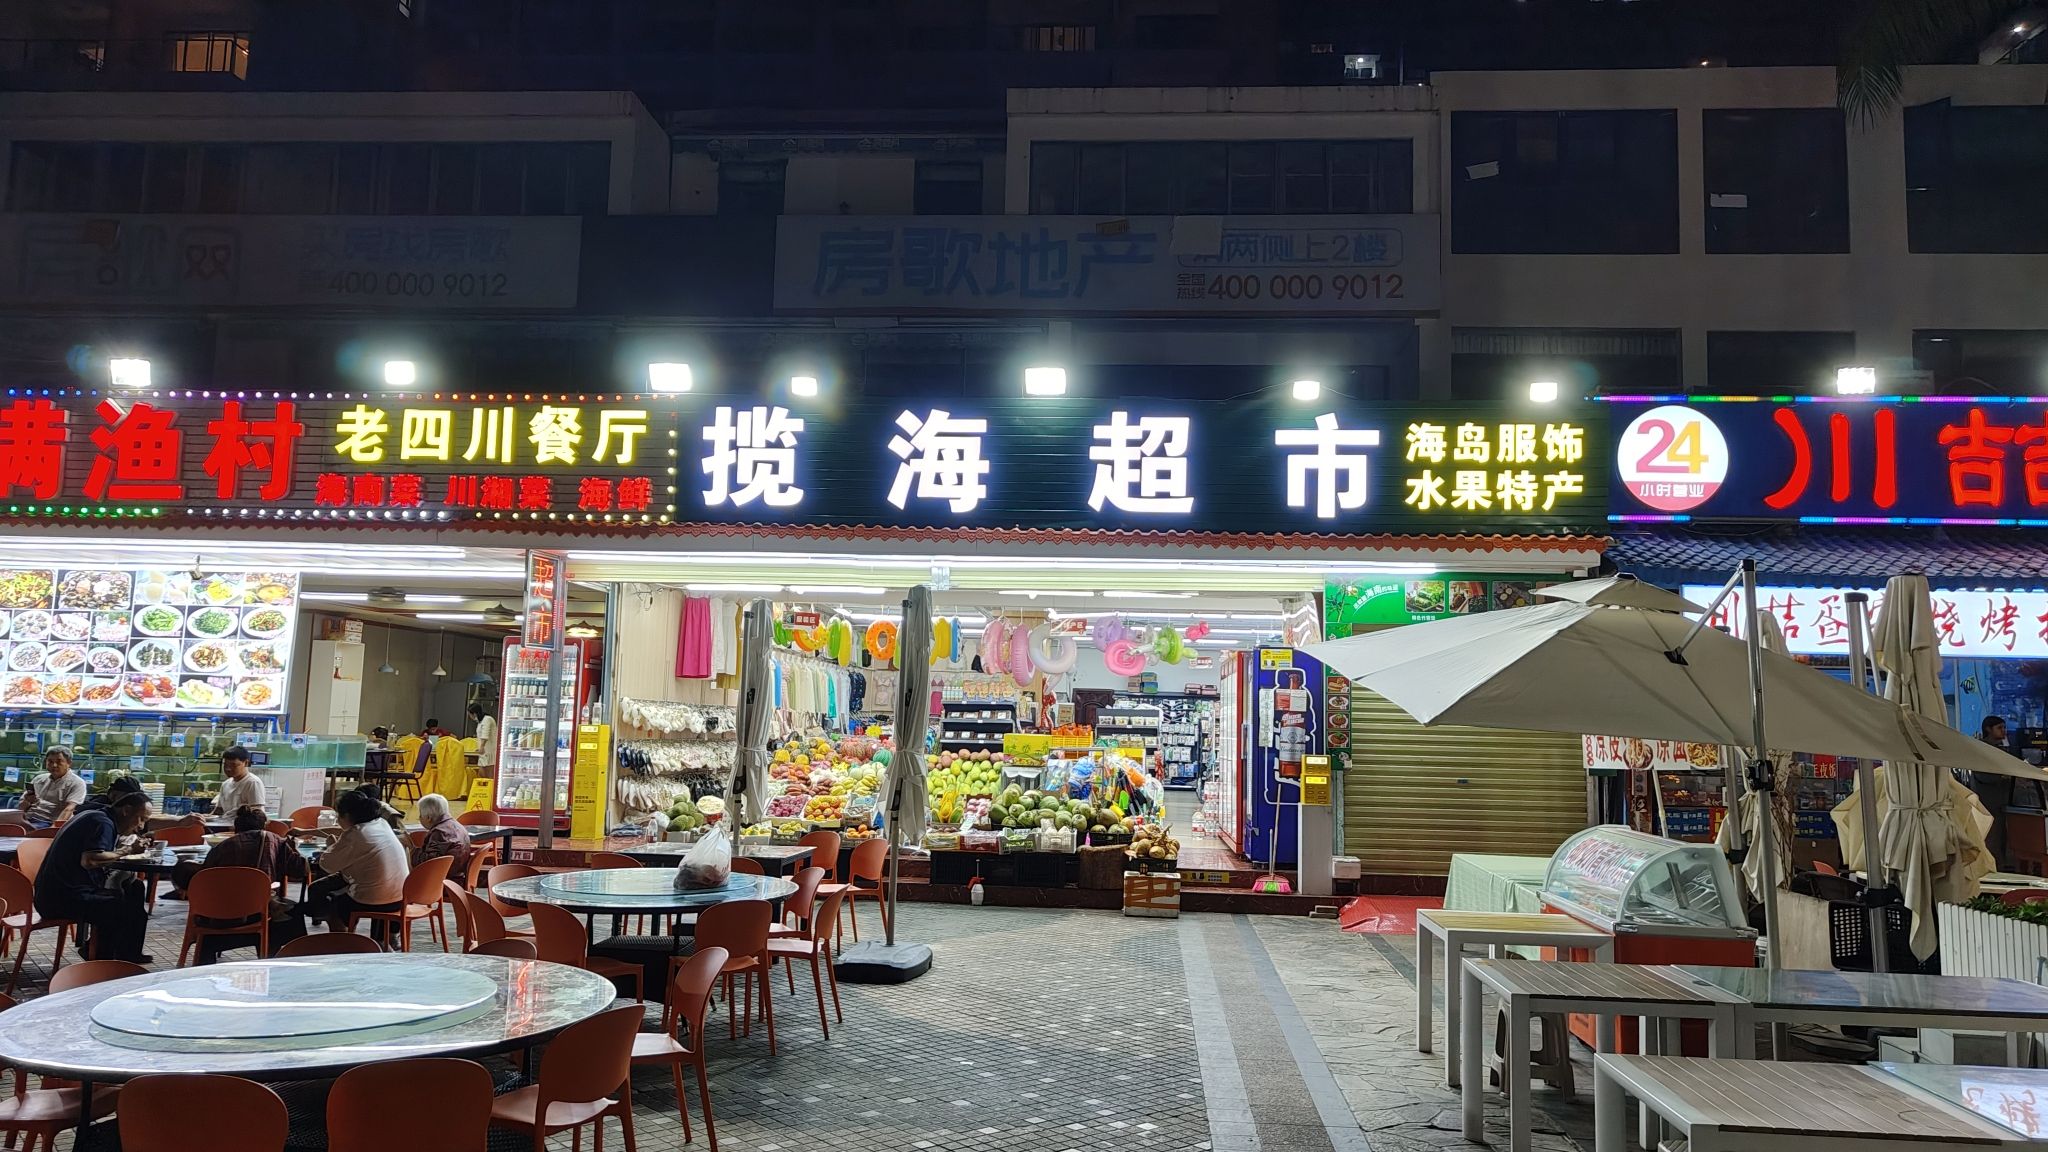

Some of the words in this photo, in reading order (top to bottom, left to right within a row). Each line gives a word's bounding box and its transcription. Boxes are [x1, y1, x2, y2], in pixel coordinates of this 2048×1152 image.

[814, 226, 1158, 299] 房歌地产
[330, 272, 379, 295] 400
[385, 273, 435, 296] 000
[443, 273, 509, 297] 9012
[1207, 274, 1261, 300] 400
[1269, 274, 1324, 300] 000
[1332, 274, 1404, 300] 9012
[0, 398, 304, 502] 满渔村
[335, 404, 649, 465] 老四川餐厅
[1405, 422, 1584, 464] 海岛服饰
[1636, 419, 1709, 474] 24
[702, 405, 1382, 519] 揽海超市
[314, 473, 423, 507] 海南菜
[443, 475, 552, 510] 川湘菜
[579, 477, 653, 511] 海鲜
[1405, 469, 1584, 512] 水果特产
[1639, 484, 1705, 498] 小时营业
